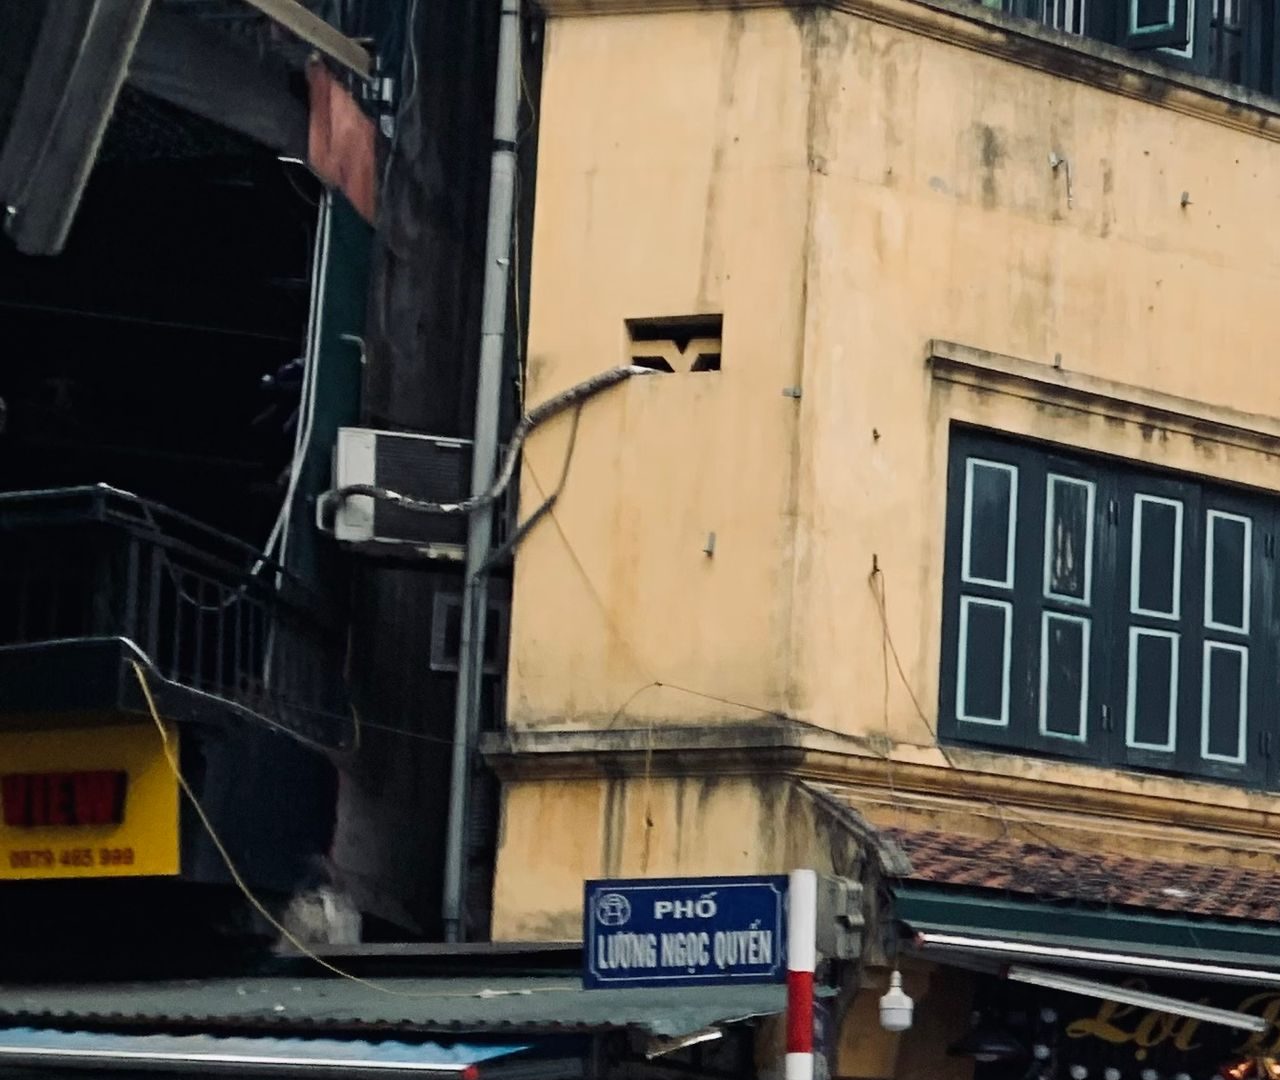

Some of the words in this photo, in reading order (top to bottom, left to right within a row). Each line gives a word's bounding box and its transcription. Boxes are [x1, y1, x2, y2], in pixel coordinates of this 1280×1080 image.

[654, 891, 717, 920] PHỐ
[597, 931, 657, 970] LƯƠNG
[661, 931, 710, 974] NGỌC
